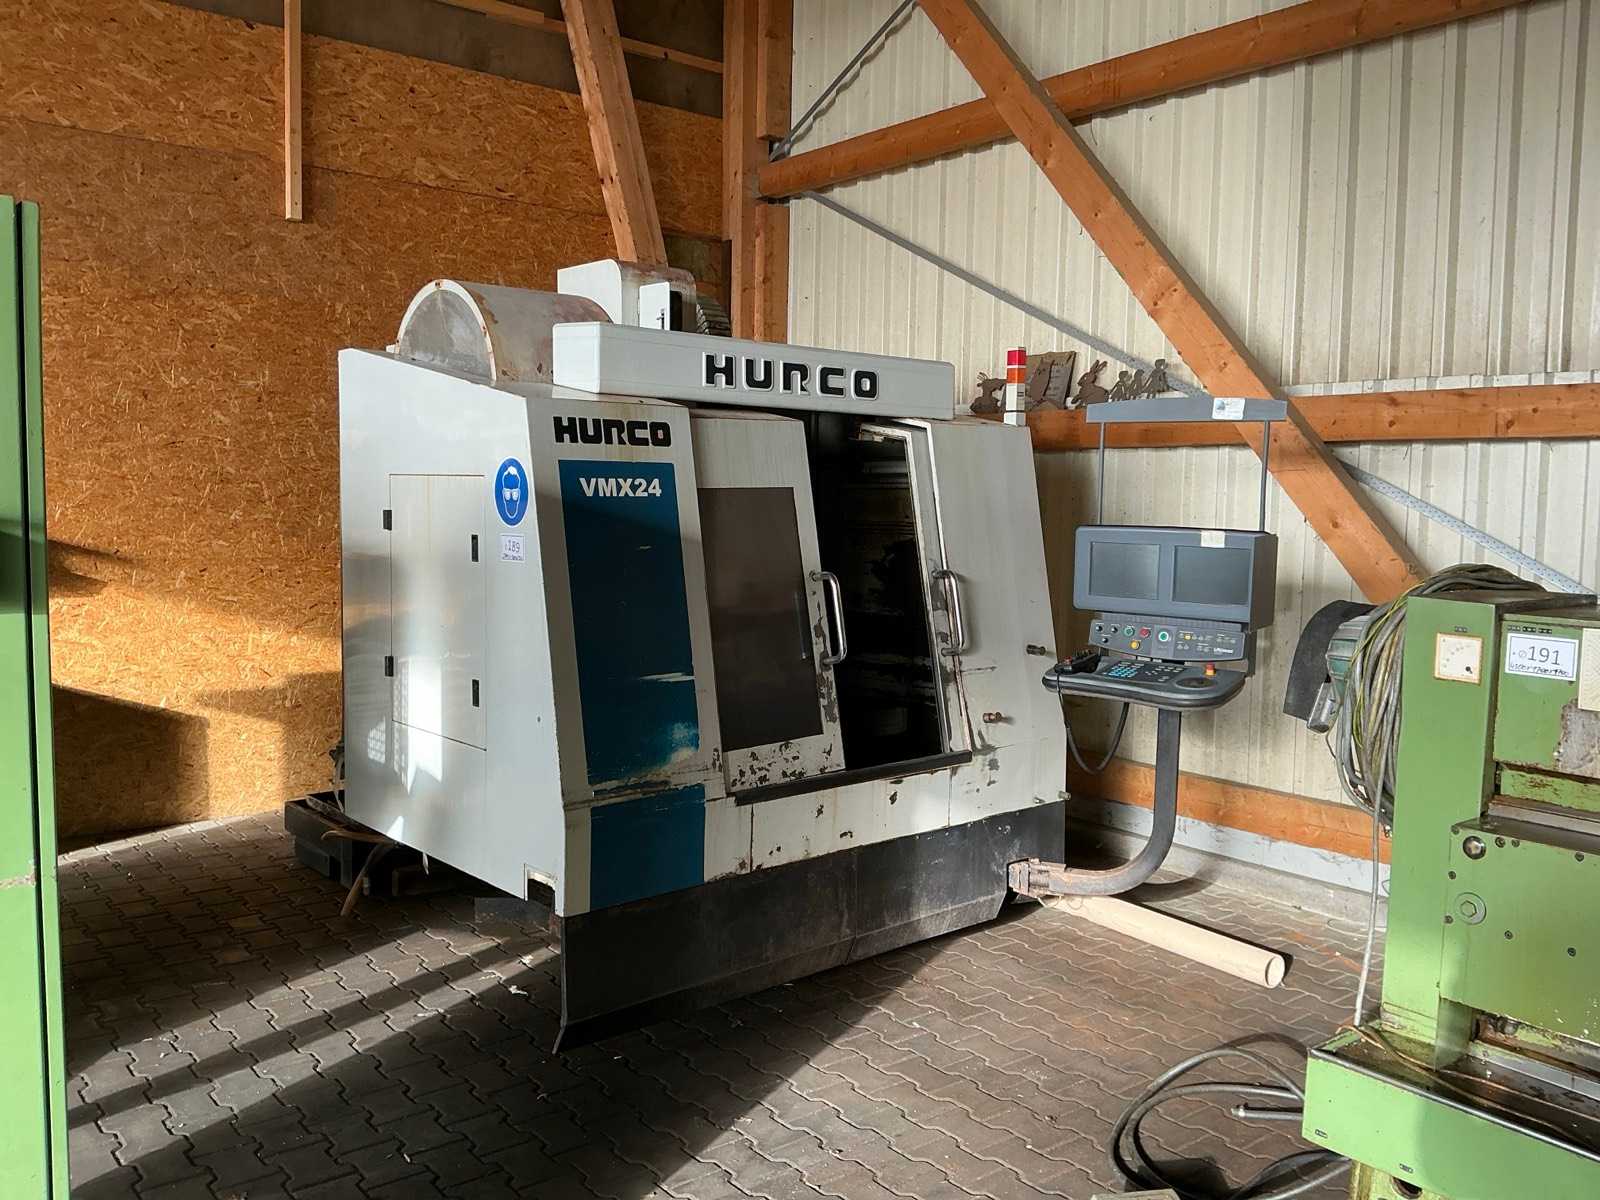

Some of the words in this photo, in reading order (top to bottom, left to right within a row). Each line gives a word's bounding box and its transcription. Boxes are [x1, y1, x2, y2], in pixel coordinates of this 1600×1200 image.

[705, 353, 878, 399] HURCO
[553, 416, 672, 447] HURCO
[579, 477, 662, 498] VMX24
